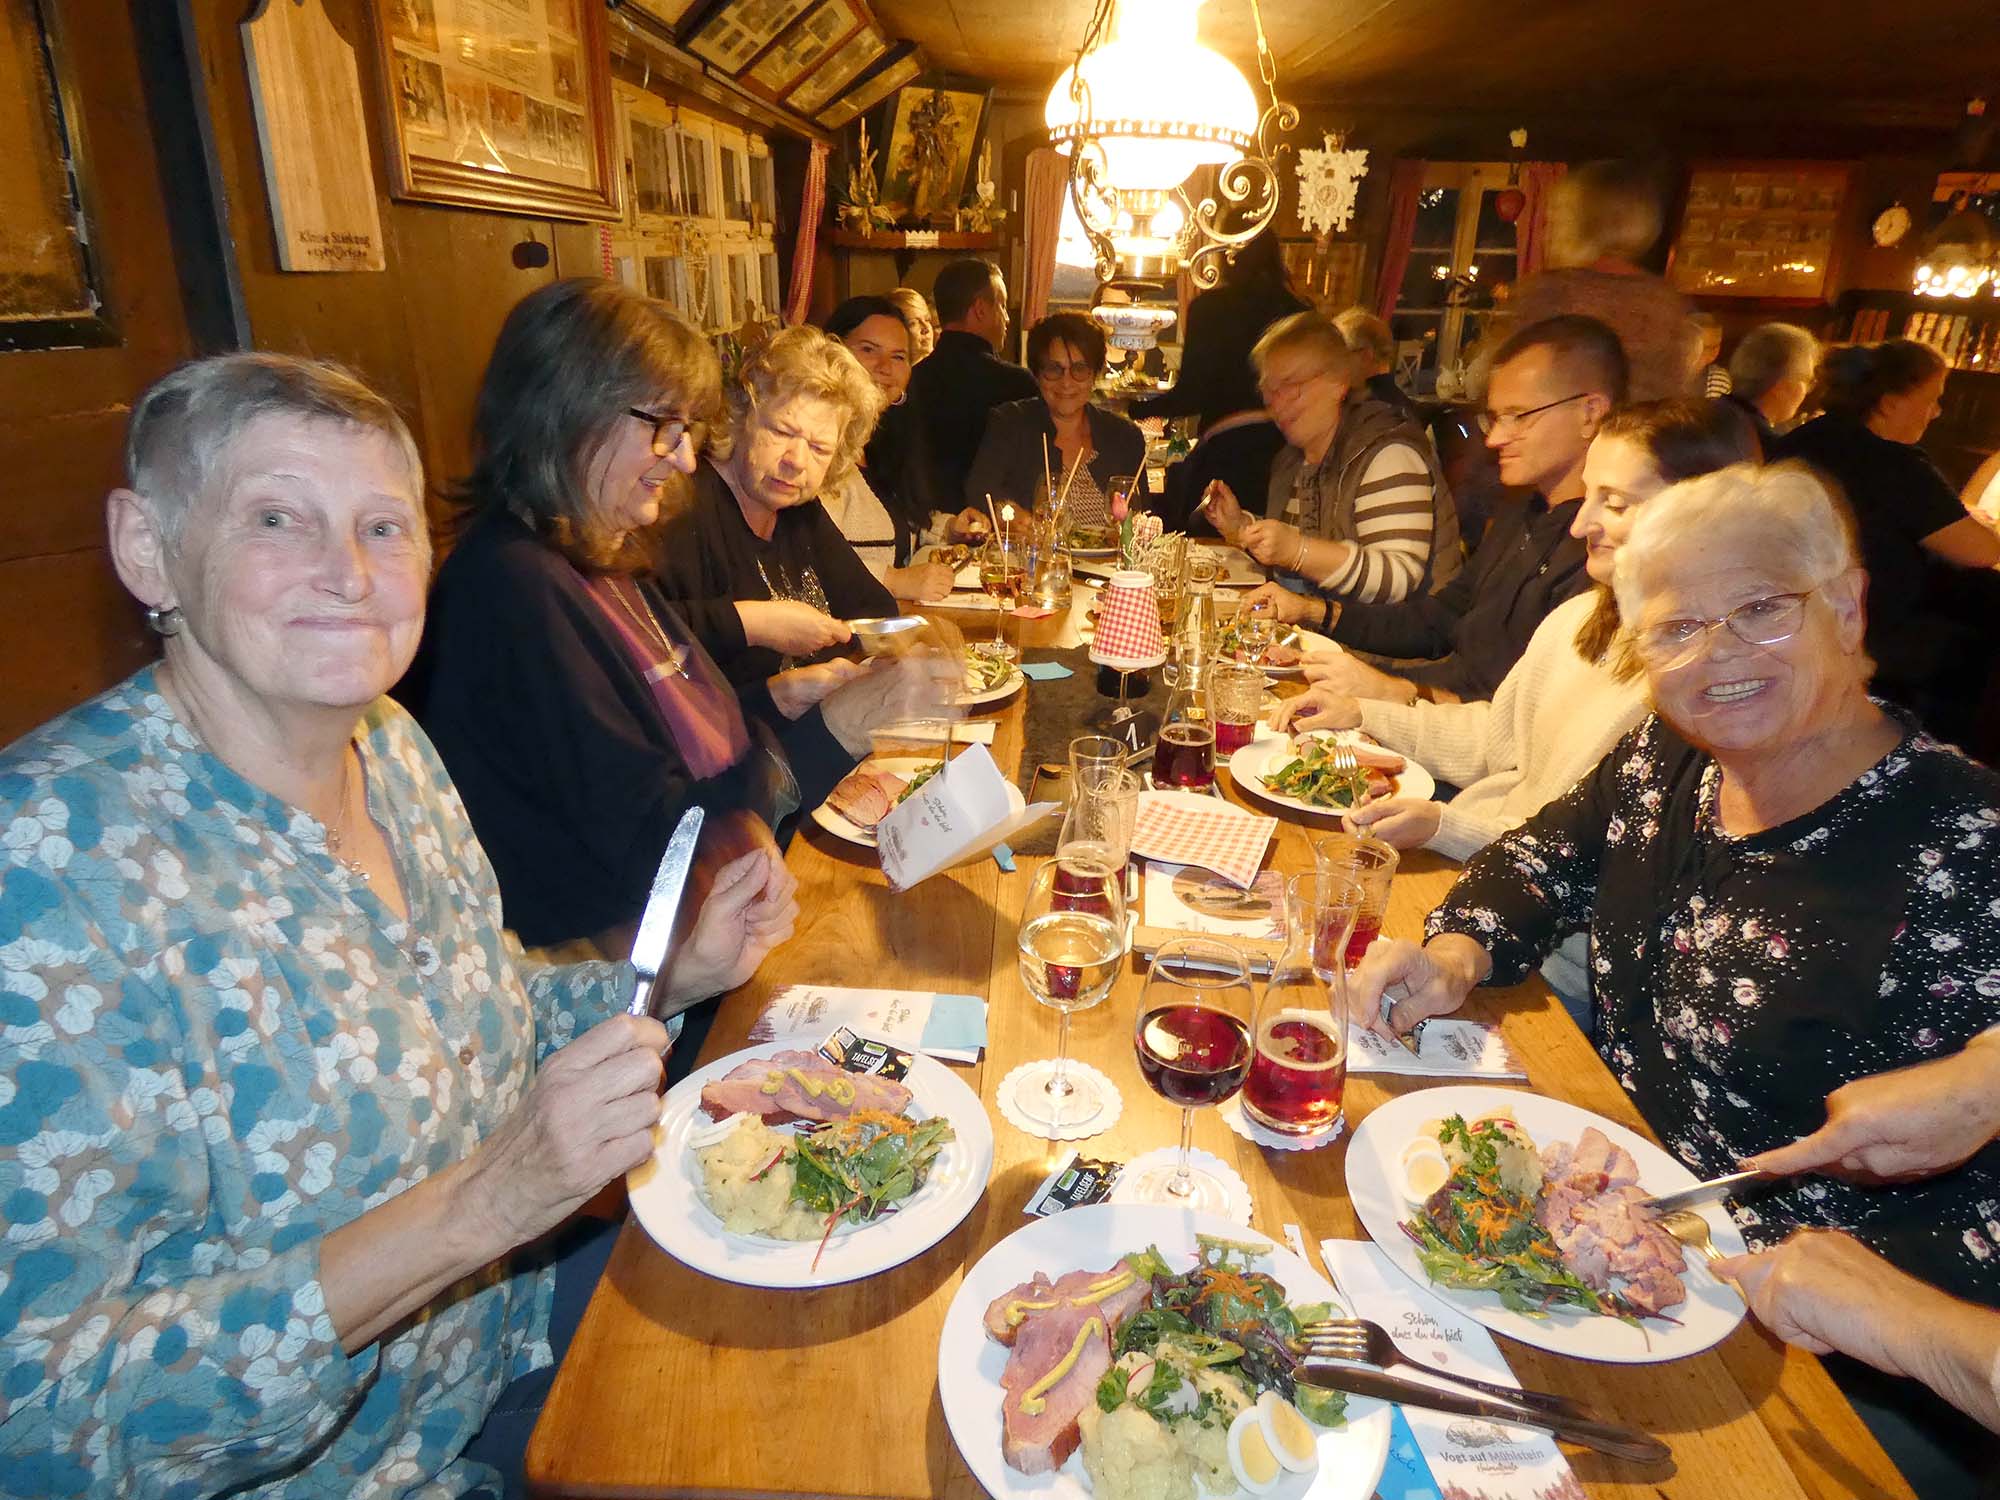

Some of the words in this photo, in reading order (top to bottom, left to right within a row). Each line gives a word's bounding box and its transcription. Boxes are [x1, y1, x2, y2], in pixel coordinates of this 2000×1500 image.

[1444, 1327, 1463, 1342] bist
[1440, 1452, 1469, 1464] Vogt
[1470, 1451, 1487, 1462] auf
[1488, 1449, 1545, 1461] Mühlstein
